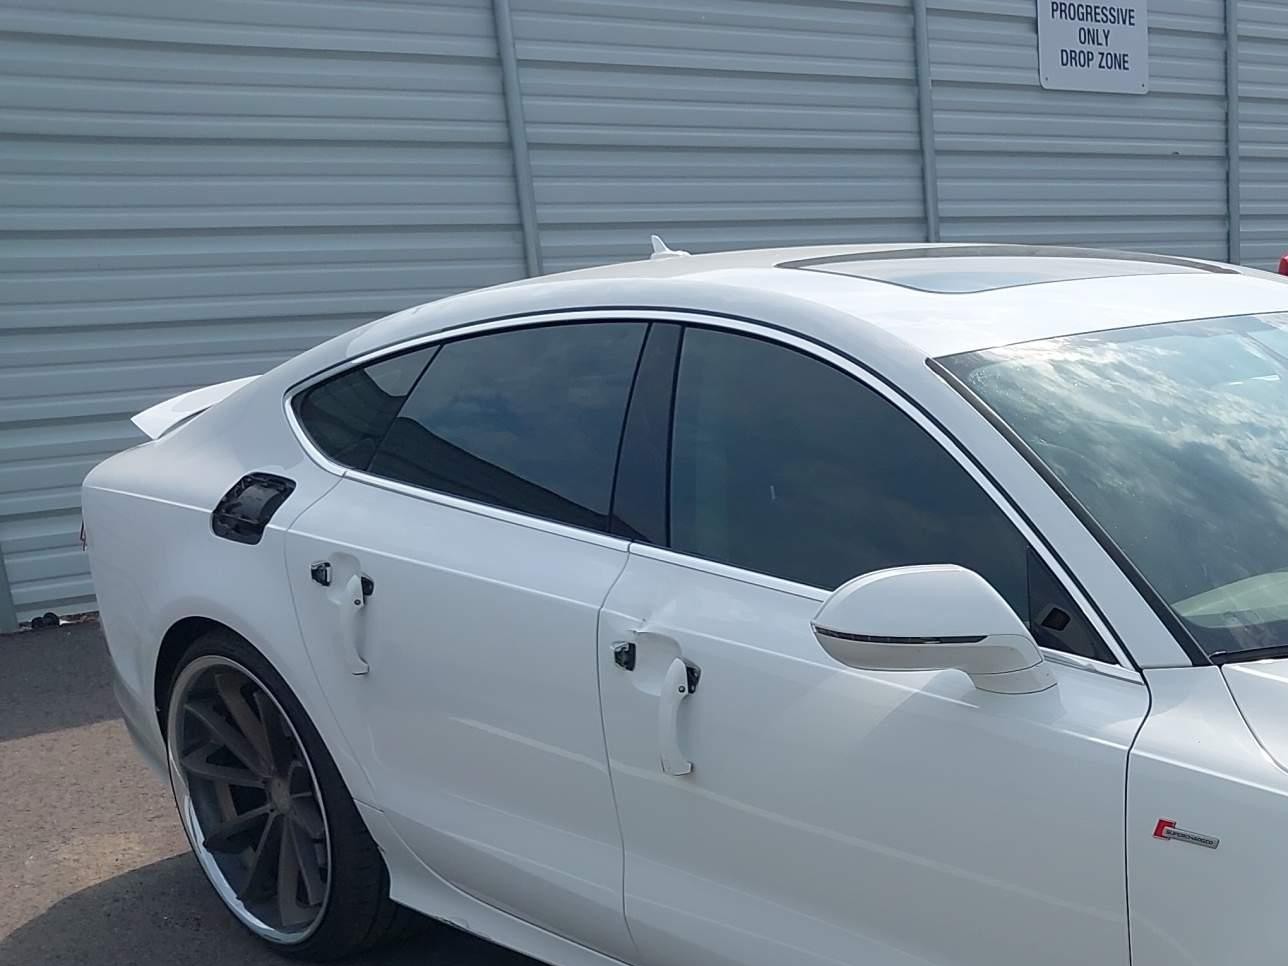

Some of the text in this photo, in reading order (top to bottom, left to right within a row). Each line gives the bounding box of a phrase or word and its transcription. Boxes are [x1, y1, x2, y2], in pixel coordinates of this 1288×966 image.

[1051, 1, 1135, 26] PROGRESSIVE
[1078, 27, 1110, 47] ONLY
[1060, 49, 1130, 71] DROP ZONE
